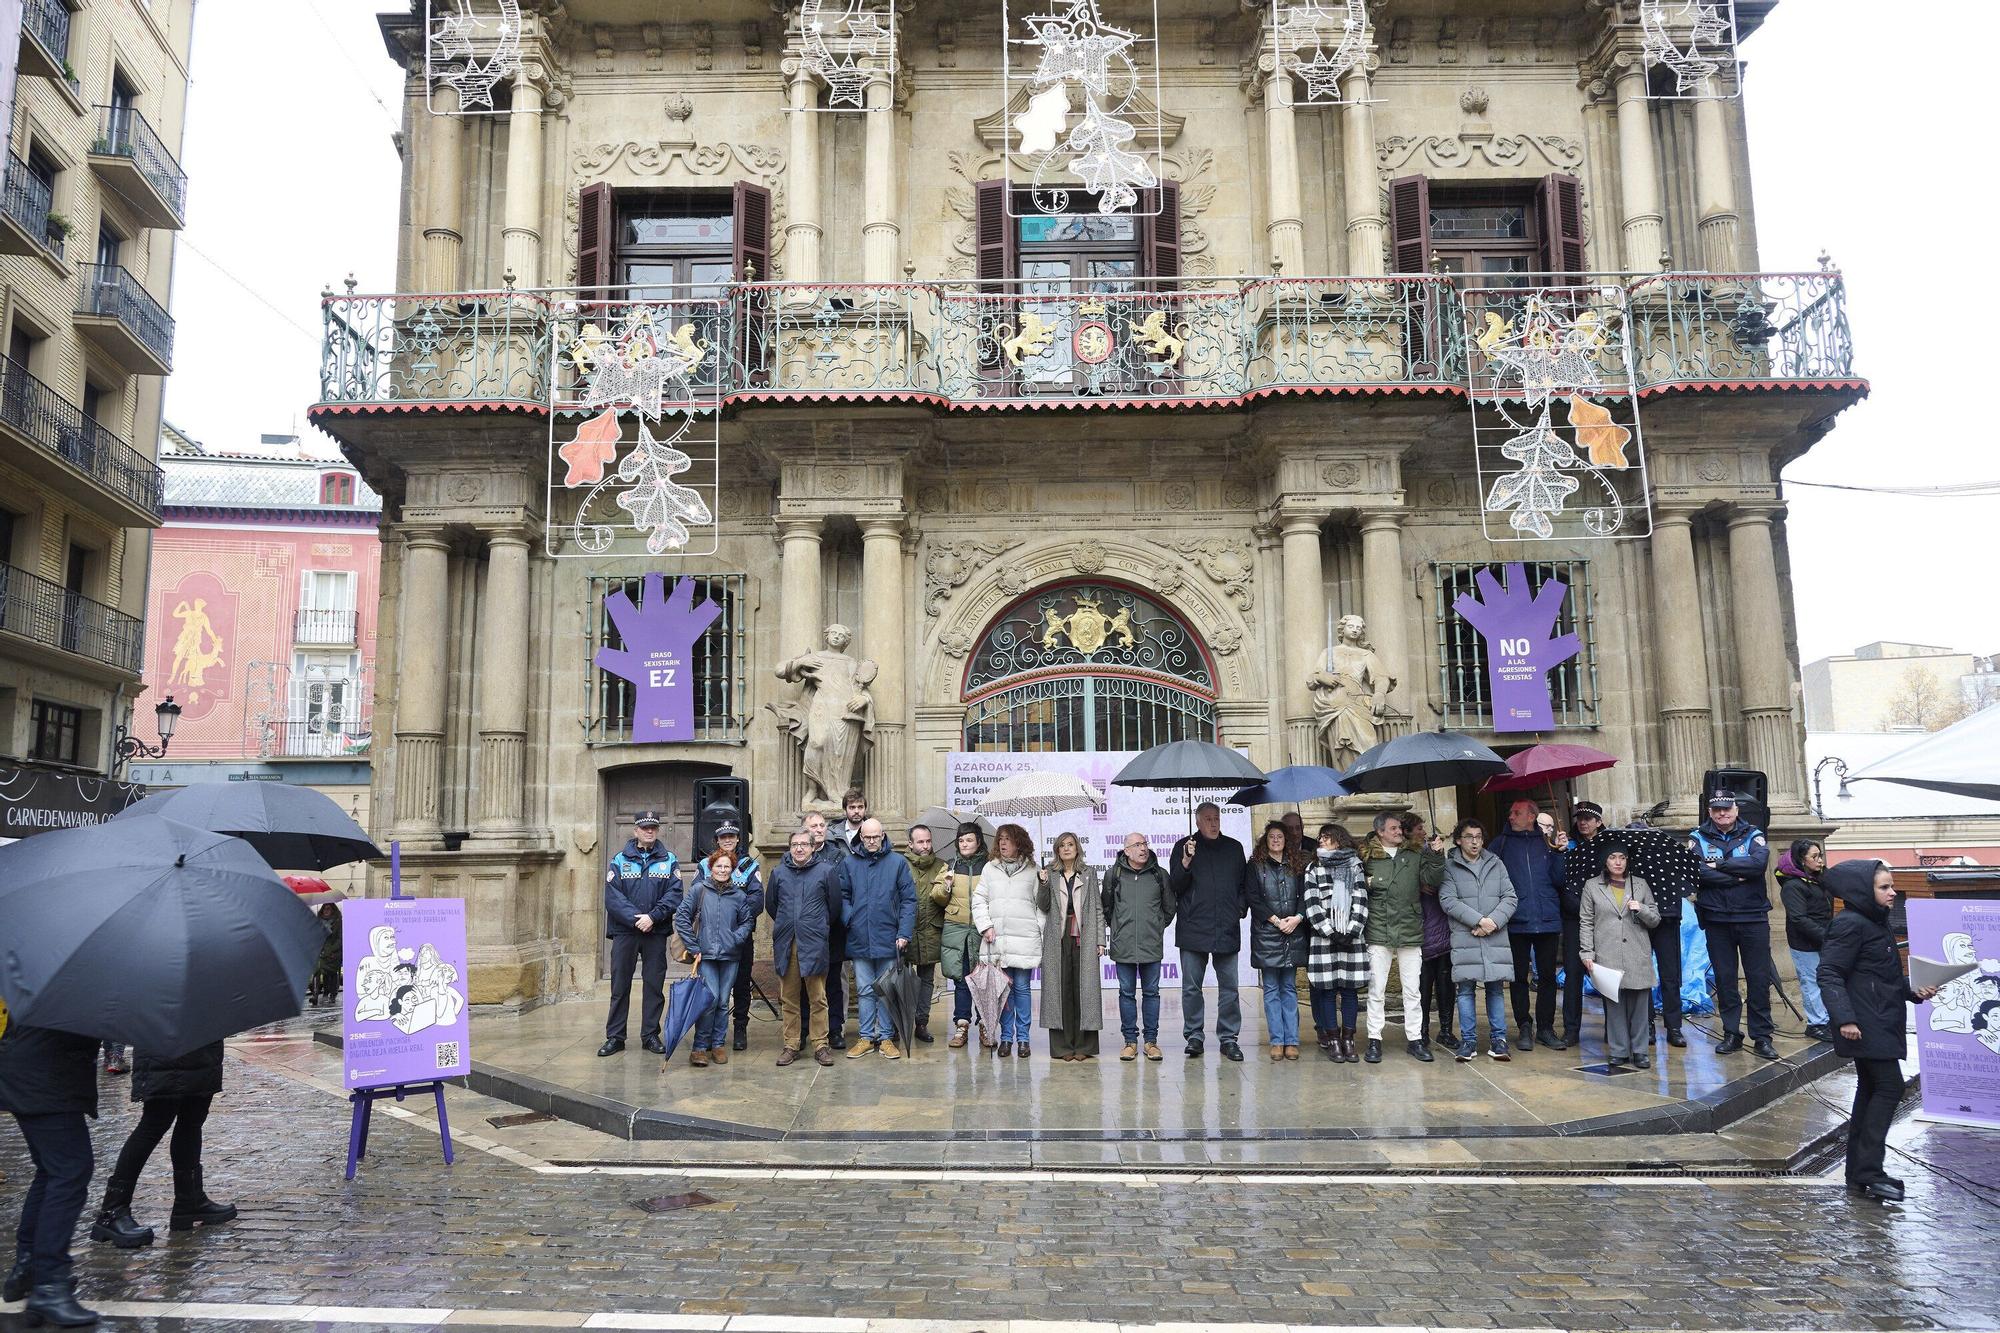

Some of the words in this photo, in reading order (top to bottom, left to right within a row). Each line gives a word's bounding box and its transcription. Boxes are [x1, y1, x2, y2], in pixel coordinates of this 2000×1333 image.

[943, 664, 954, 694] PATET
[966, 591, 1002, 629] OMNIBUS
[1118, 560, 1139, 572] COR
[1184, 594, 1210, 621] VALDE
[1227, 660, 1240, 693] MAGIS
[1500, 638, 1530, 657] NO
[650, 651, 672, 659] ERASO
[643, 659, 680, 668] SEXISTARIK
[649, 669, 676, 688] EZ
[1503, 673, 1533, 681] SEXISTAS
[954, 762, 1012, 772] AZAROAK
[1017, 763, 1034, 773] 25,
[954, 775, 1007, 784] Emakume
[954, 798, 981, 806] Ezab
[1165, 796, 1178, 804] de
[1182, 796, 1190, 804] la
[1194, 795, 1232, 803] Violenc
[1092, 802, 1107, 815] NO
[1151, 807, 1180, 816] hacia
